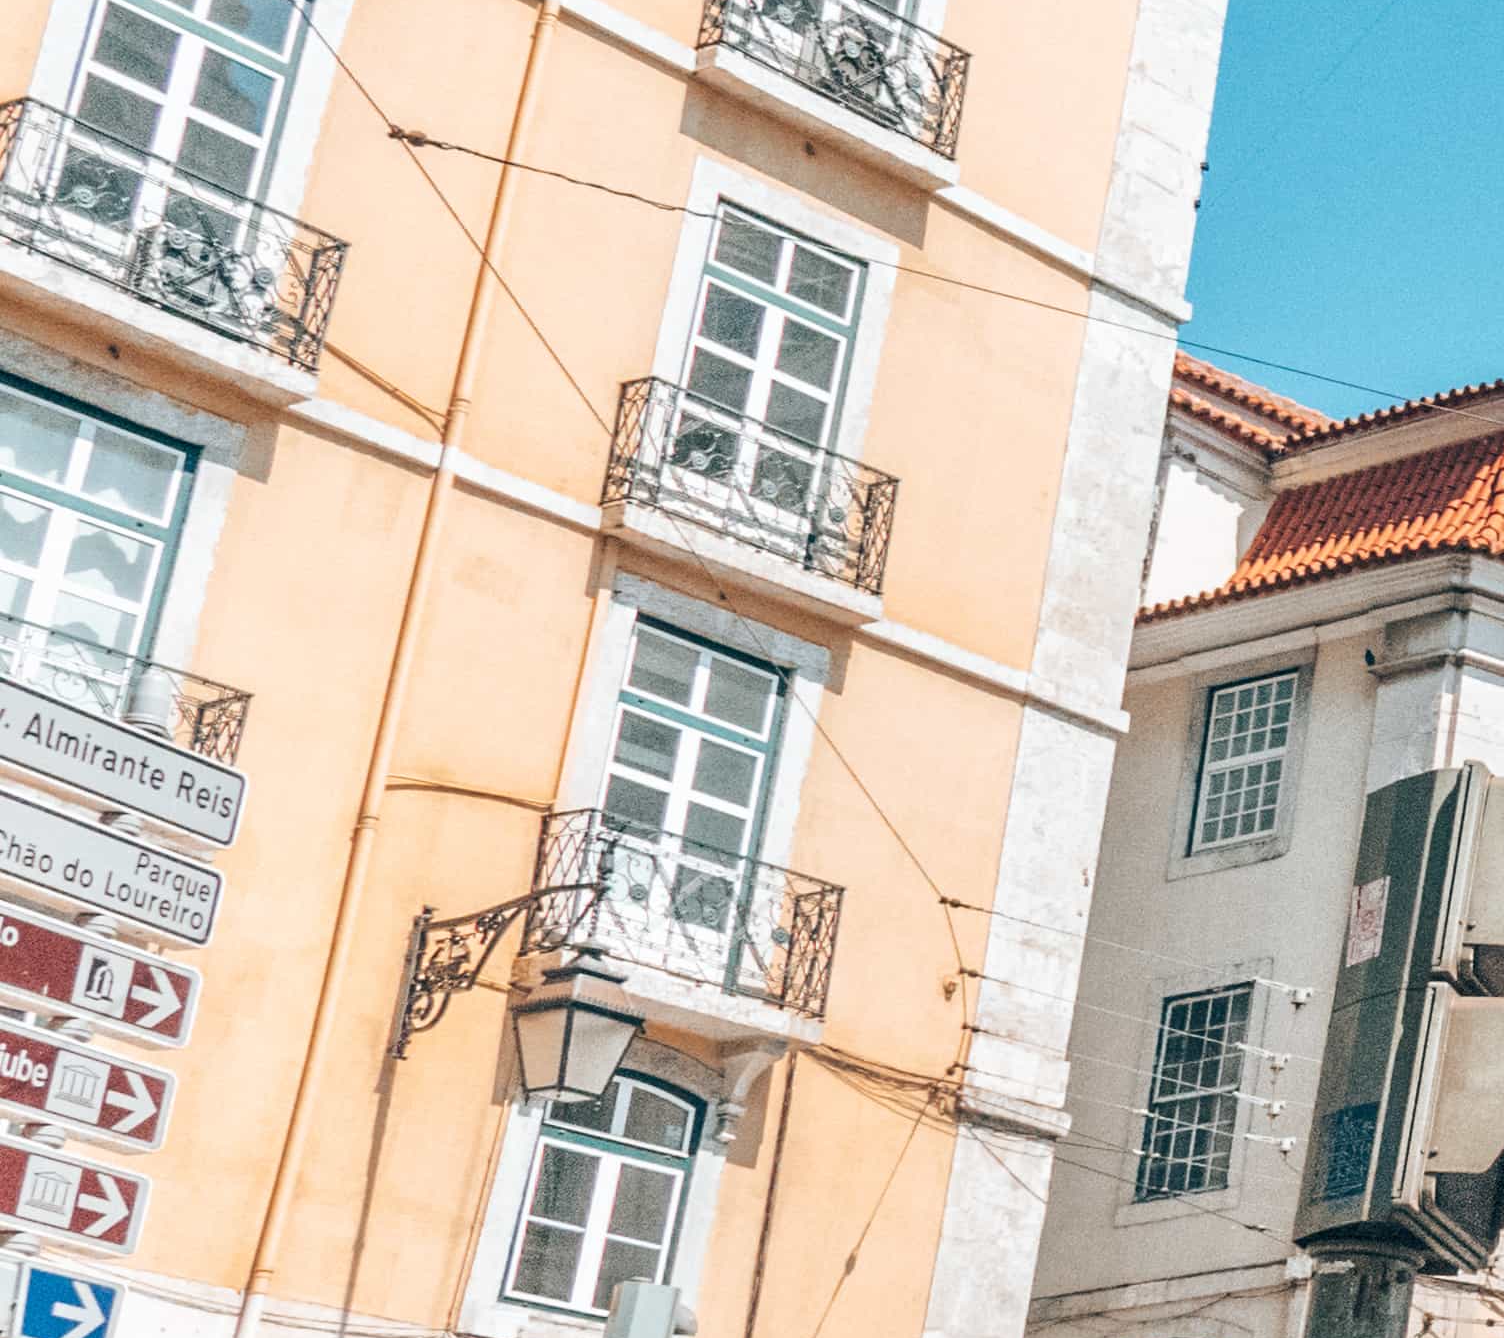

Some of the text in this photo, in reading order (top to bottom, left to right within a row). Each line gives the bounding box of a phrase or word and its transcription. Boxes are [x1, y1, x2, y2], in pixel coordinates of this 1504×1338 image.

[22, 713, 234, 819] Almirante Reis
[63, 859, 94, 889] do
[103, 871, 204, 931] Loureiro
[134, 852, 211, 903] Parque
